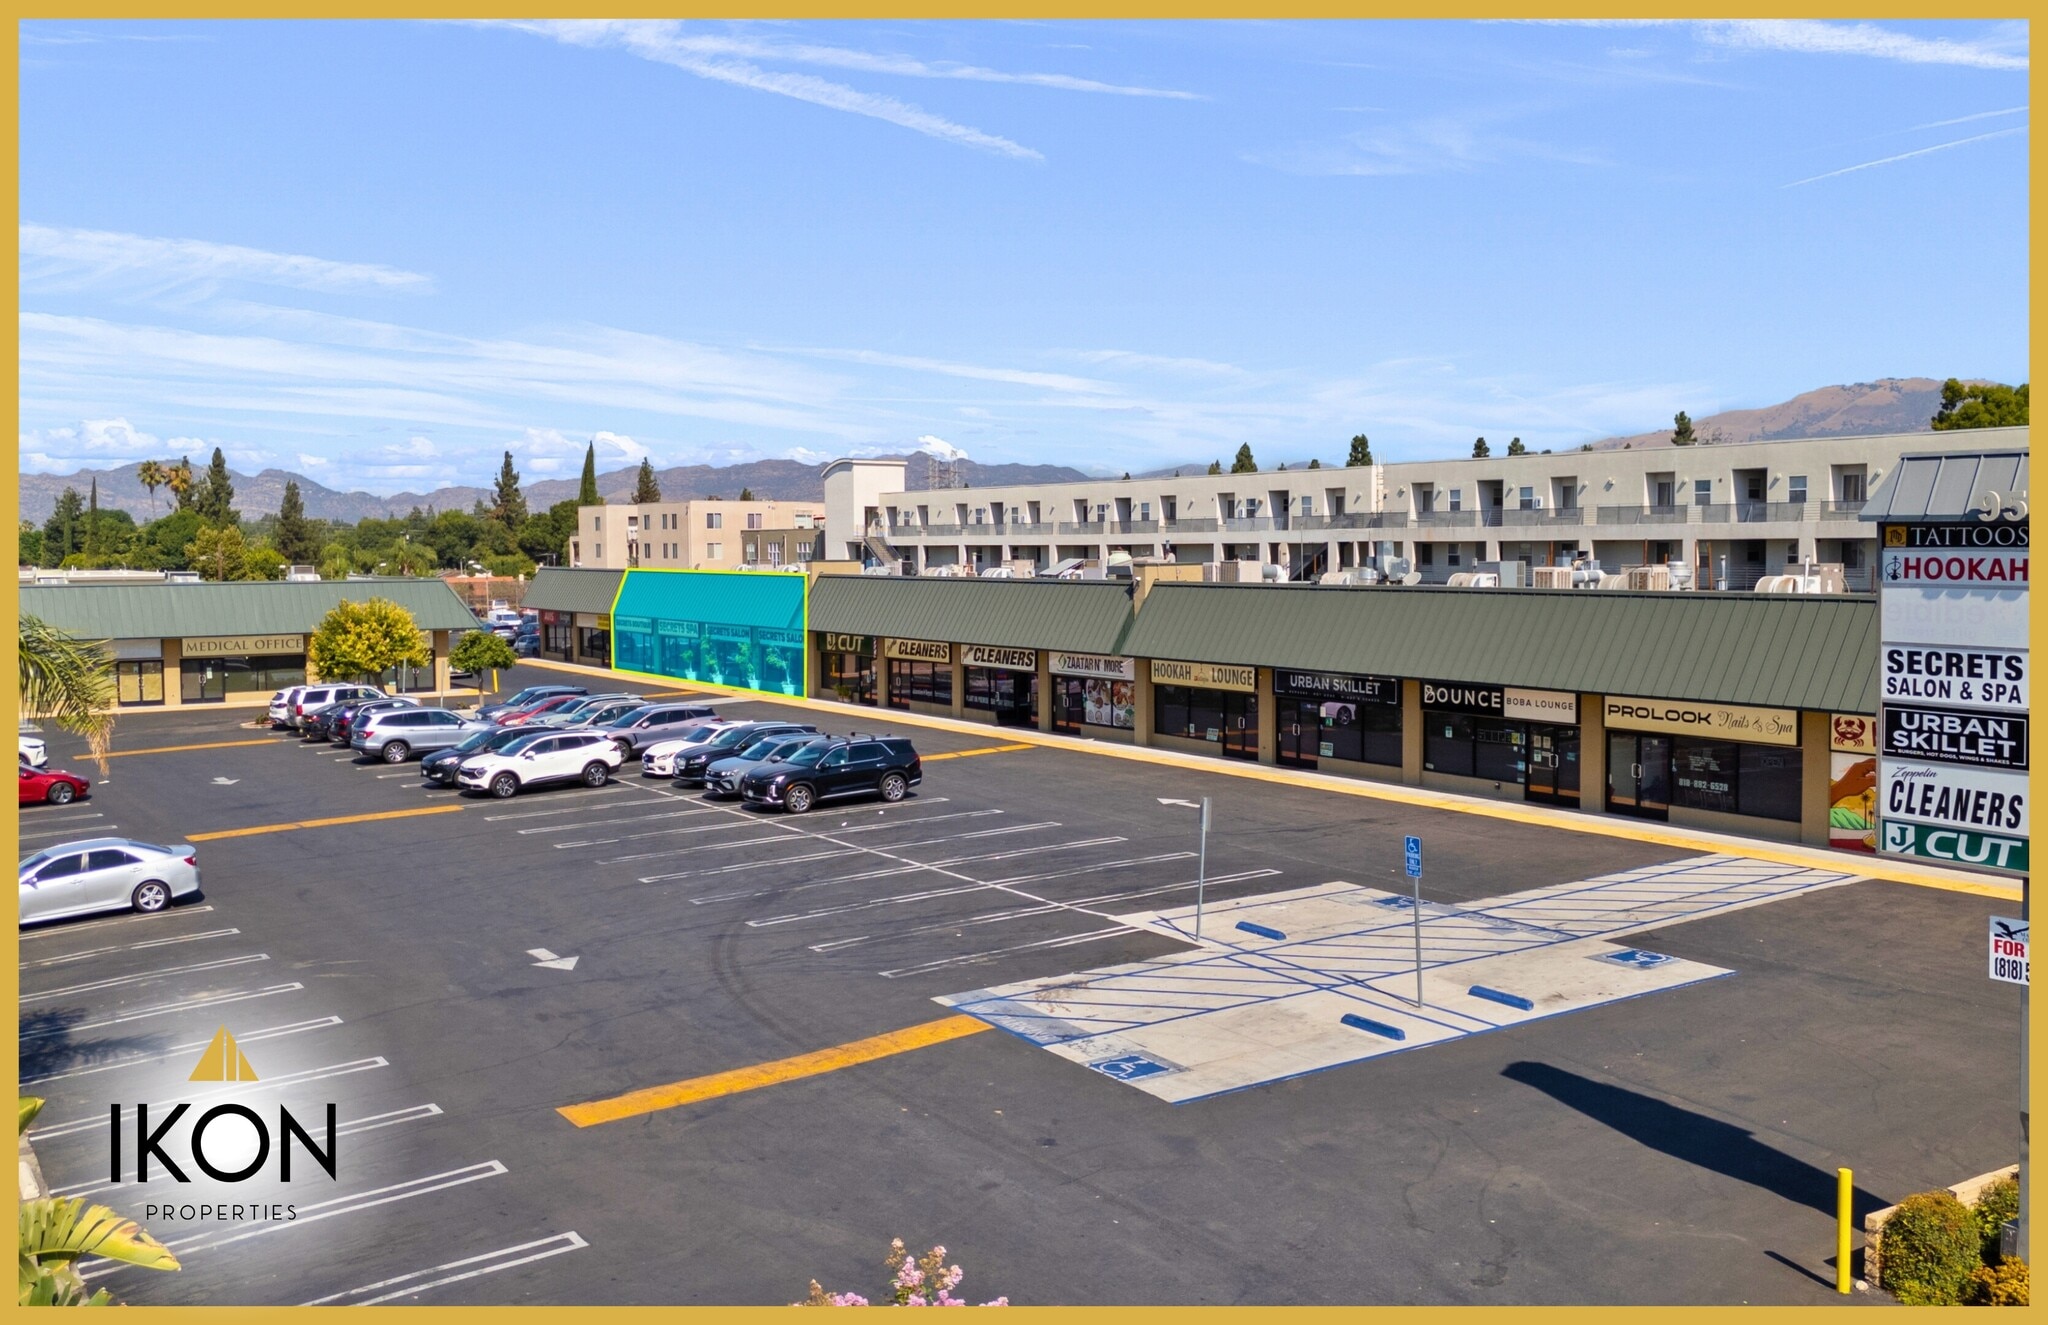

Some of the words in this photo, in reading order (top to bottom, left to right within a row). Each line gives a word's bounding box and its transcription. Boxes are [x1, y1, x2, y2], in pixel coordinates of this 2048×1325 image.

[1911, 526, 2028, 545] TATTOOS
[1903, 557, 2028, 581] HOOKAH
[659, 620, 685, 634] SECRETS
[685, 623, 698, 635] SPA
[707, 625, 730, 636] SECRETS
[730, 628, 750, 638] SALON
[759, 630, 785, 642] SECRETS
[786, 633, 804, 644] SALO
[186, 640, 249, 652] MEDICAL
[254, 639, 302, 650] OFFICE
[838, 635, 865, 652] CUT
[898, 641, 948, 659] CLEANERS
[973, 647, 1035, 667] CLEANERS
[1104, 659, 1124, 673] MORE
[1887, 649, 2023, 681] SECRETS
[1153, 662, 1191, 680] HOOKAH
[1211, 667, 1253, 686] LOUNGE
[1289, 674, 1330, 690] URBAN
[1333, 679, 1381, 695] SKILLET
[1886, 676, 1951, 699] SALON
[1960, 681, 1973, 700] &
[1981, 683, 2022, 704] SPA
[1424, 684, 1501, 708] BOUNCE
[1506, 697, 1531, 707] BOBA
[1535, 700, 1574, 711] LOUNGE
[1607, 704, 1712, 725] PROLOOK
[1717, 710, 1750, 730] Nails
[1752, 716, 1763, 733] &
[1765, 715, 1793, 735] Spa
[1900, 712, 2009, 739] URBAN
[1892, 730, 2017, 758] SKILLET
[1986, 757, 2010, 765] SHAKES
[1891, 766, 1938, 782] Zeppelin
[1889, 779, 2024, 829] CLEANERS
[1925, 830, 2023, 867] CUT
[1994, 939, 2025, 958] FOR
[1995, 957, 2022, 981] (818)
